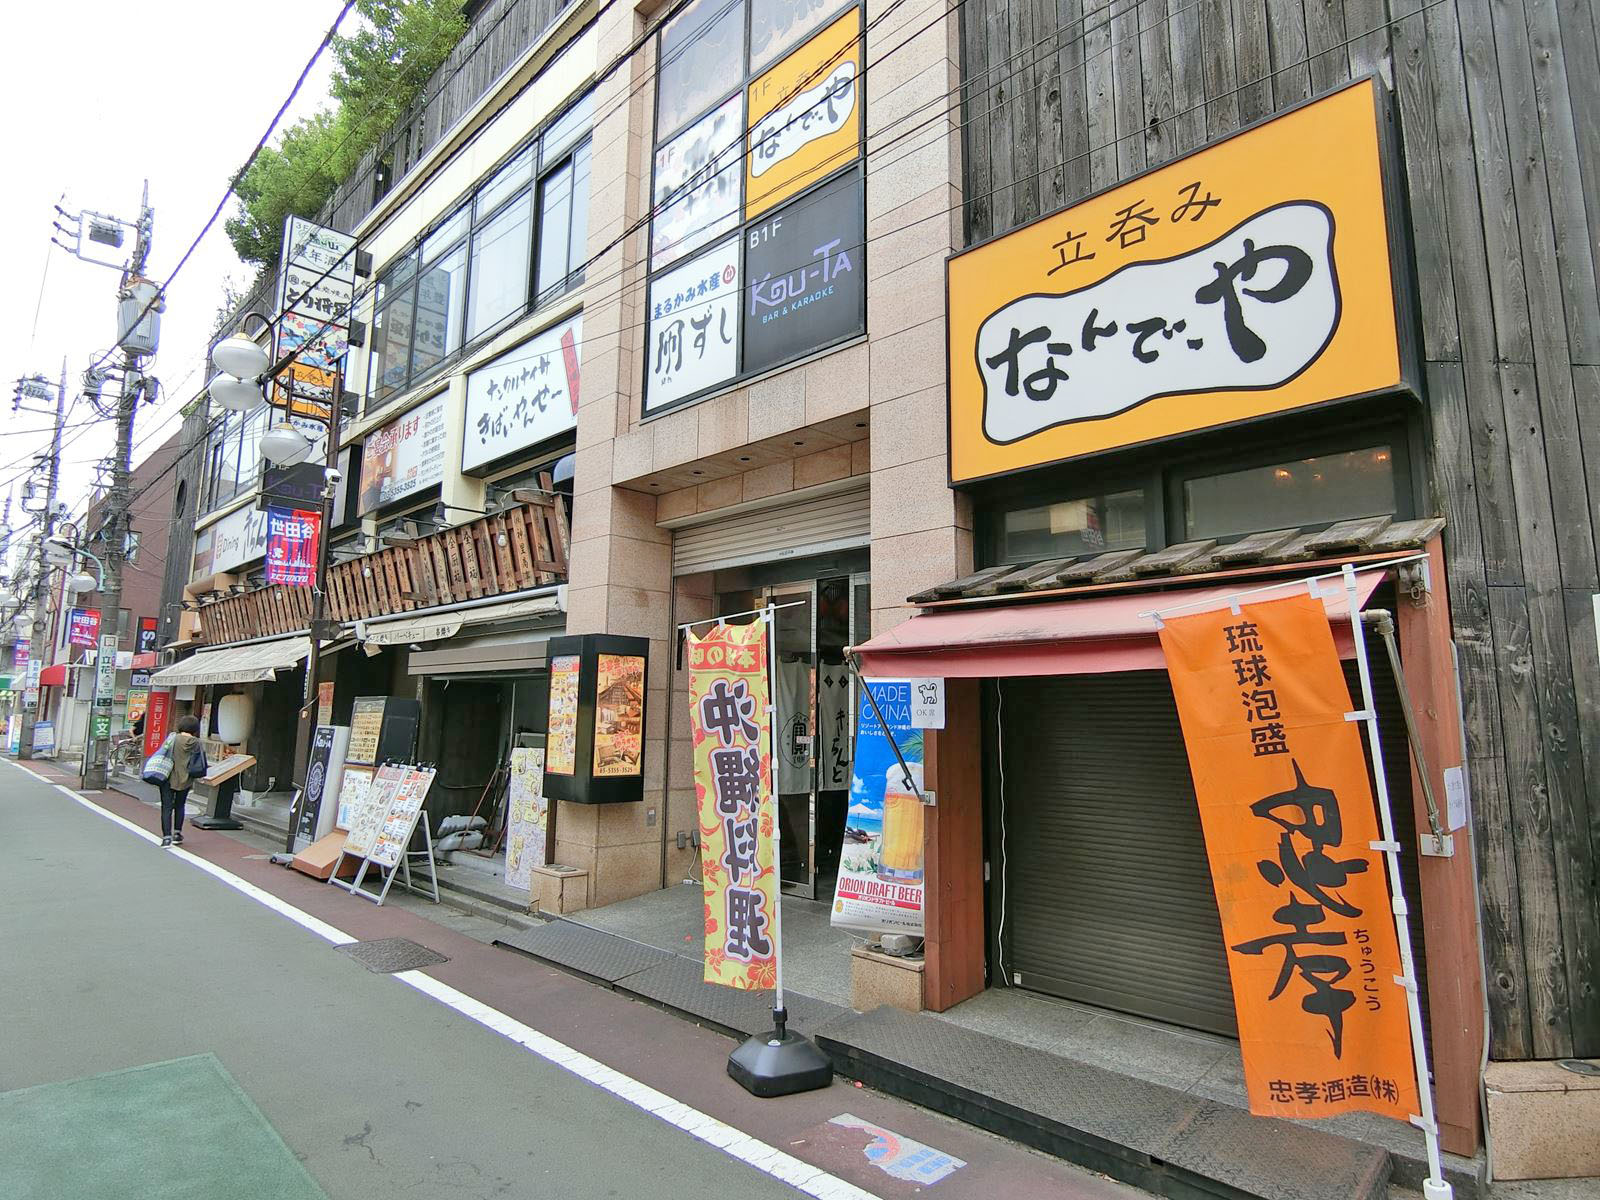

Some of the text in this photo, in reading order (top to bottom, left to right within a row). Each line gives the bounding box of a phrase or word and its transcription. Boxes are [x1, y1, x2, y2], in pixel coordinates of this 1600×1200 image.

[753, 76, 772, 102] 1F
[750, 216, 783, 249] B1F
[1046, 181, 1222, 277] 立呑み
[654, 271, 721, 319] まるかみ水産
[762, 285, 834, 324] BAR & KARAOKE
[985, 238, 1314, 402] なんでや
[270, 517, 315, 539] 世田谷
[862, 685, 908, 702] MADE
[1222, 619, 1290, 759] 琉球泡盛
[862, 703, 912, 721] OKINA
[839, 877, 922, 903] ORION DRAFT BEER
[1231, 758, 1371, 1061] 忠孝
[1352, 928, 1382, 1013] ちゅうこう
[1268, 1073, 1399, 1105] 忠孝酒造(株)
